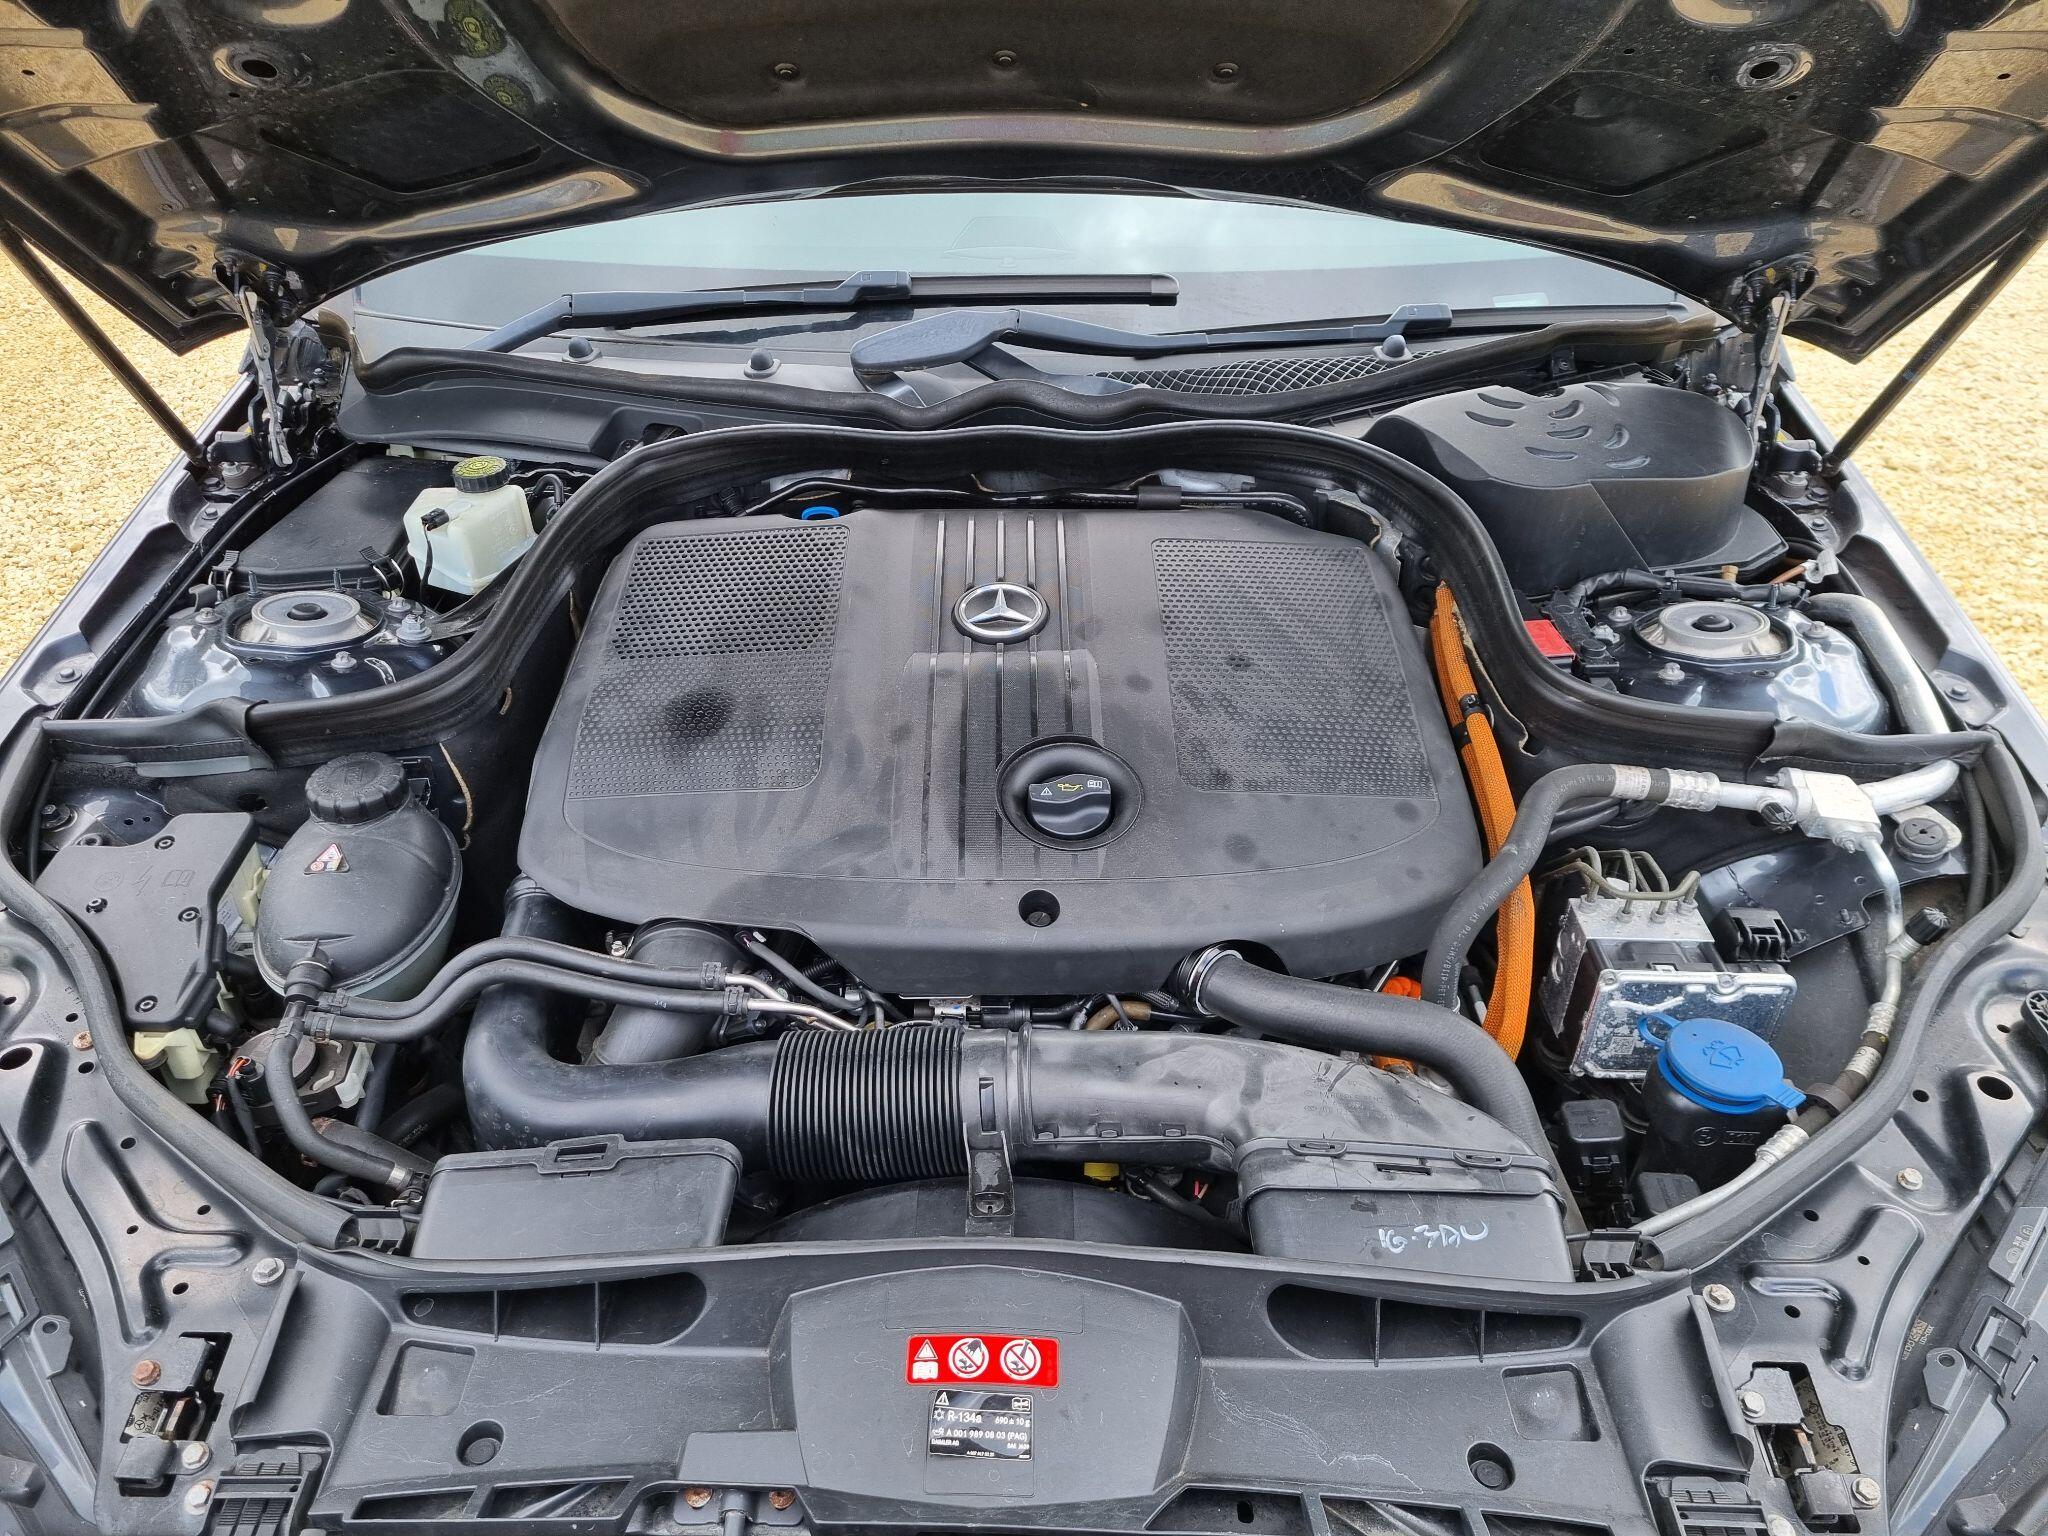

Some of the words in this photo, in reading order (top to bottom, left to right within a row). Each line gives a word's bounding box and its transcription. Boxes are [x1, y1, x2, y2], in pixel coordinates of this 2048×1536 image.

[947, 1410, 982, 1424] R-134a
[995, 1416, 1009, 1425] 690
[946, 1428, 952, 1437] A
[953, 1429, 967, 1438] 001
[969, 1430, 983, 1439] 989
[1007, 1431, 1028, 1442] (PAG)
